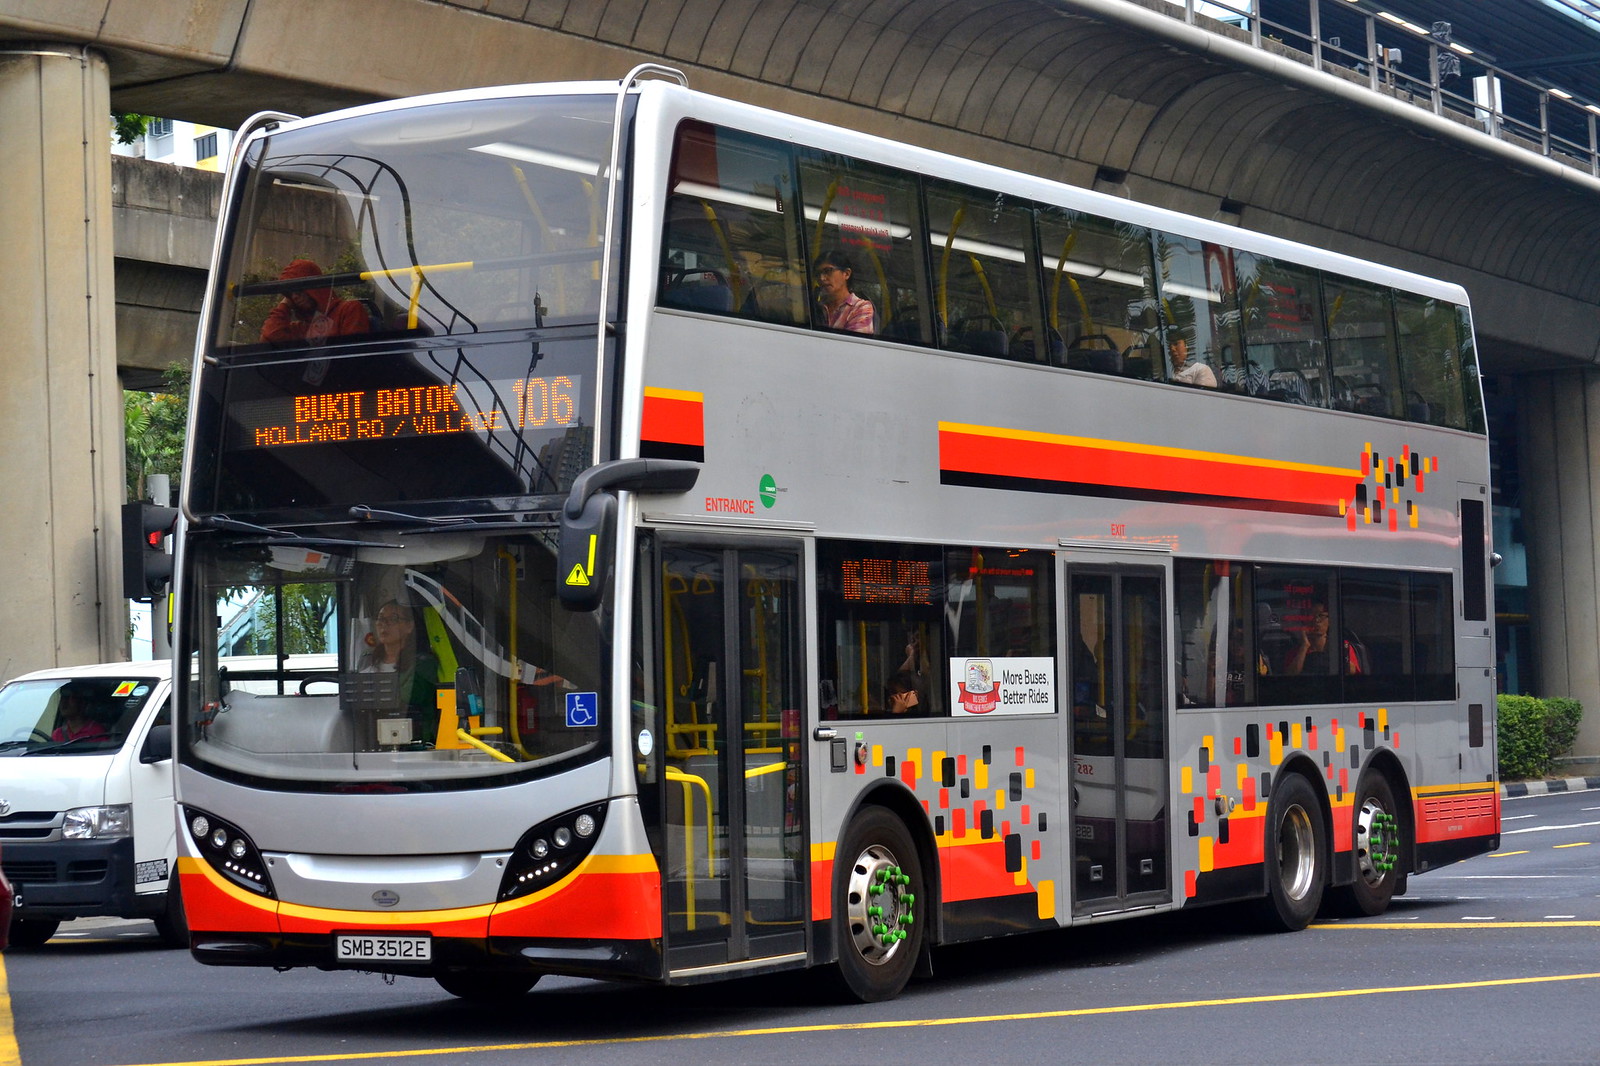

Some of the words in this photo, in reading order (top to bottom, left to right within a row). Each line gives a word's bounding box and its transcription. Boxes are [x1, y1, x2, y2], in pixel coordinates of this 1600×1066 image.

[294, 392, 364, 423] BUKIT
[377, 384, 459, 417] BATOK
[511, 376, 574, 428] 106
[255, 422, 350, 446] HOLLAND
[357, 419, 384, 439] RD
[392, 420, 405, 437] /
[412, 410, 503, 435] VILLAGE
[705, 497, 755, 514] ENTRANCE
[1111, 523, 1126, 536] EXIT
[1002, 669, 1023, 685] More
[1024, 669, 1049, 686] Buses,
[1003, 689, 1028, 705] Better
[1028, 688, 1049, 704] Rides
